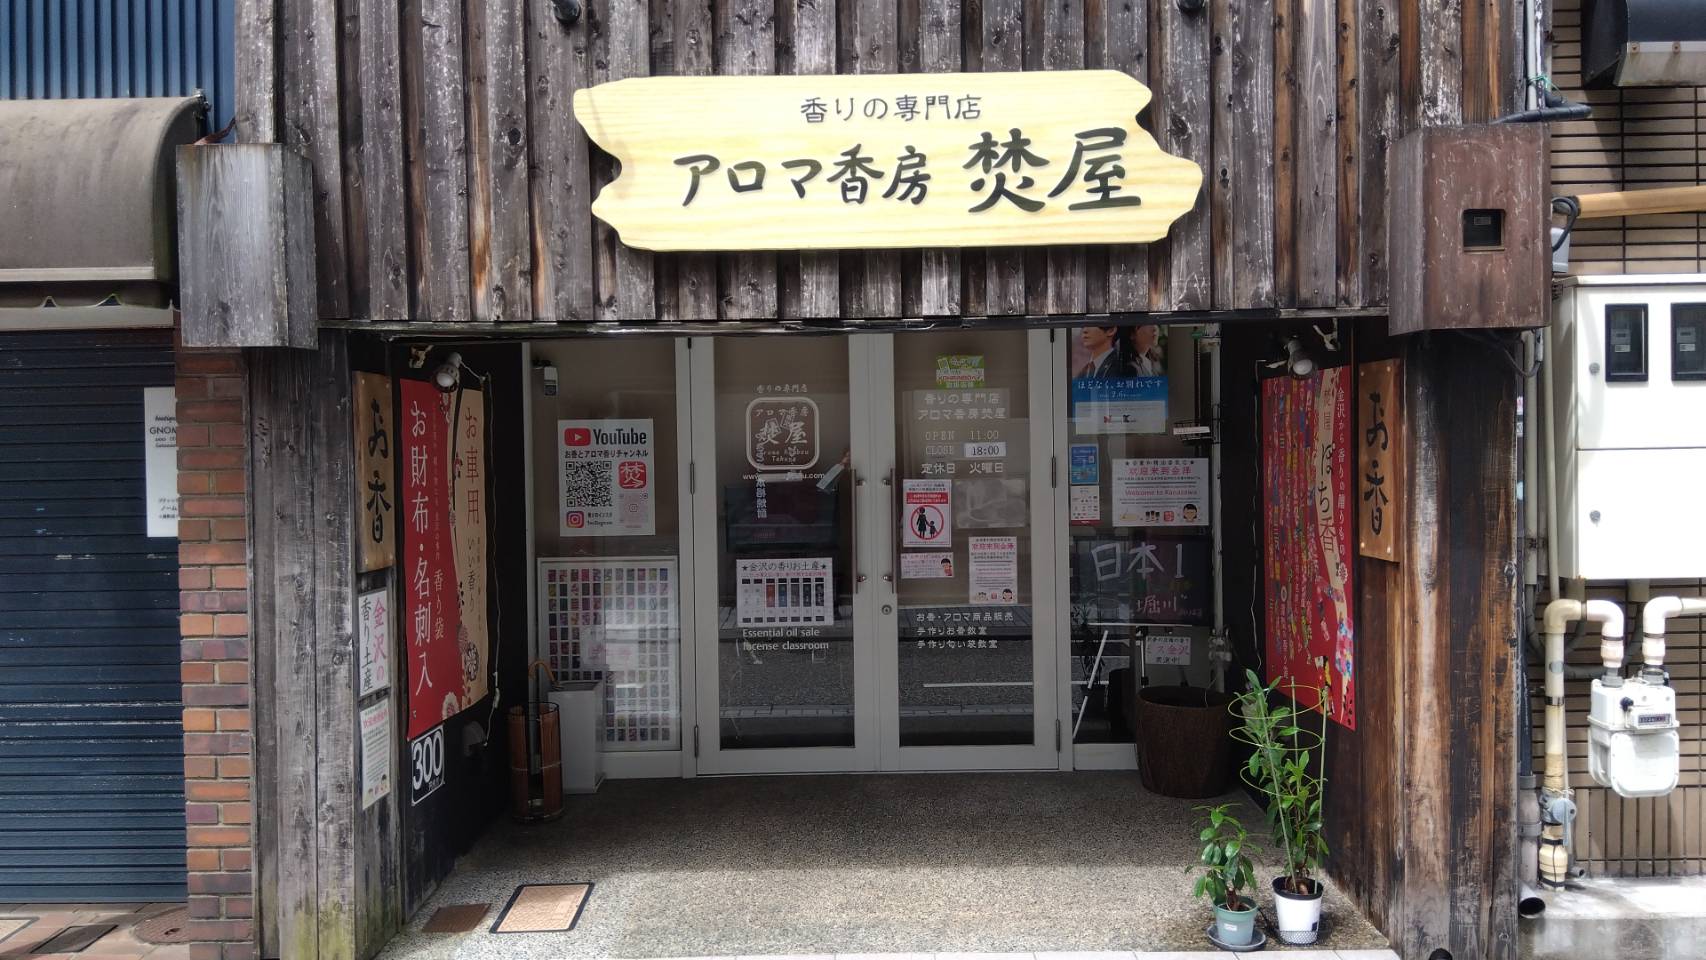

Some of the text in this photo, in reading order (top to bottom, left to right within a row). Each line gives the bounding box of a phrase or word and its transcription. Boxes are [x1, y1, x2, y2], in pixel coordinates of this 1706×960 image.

[800, 94, 983, 124] 香りの専門店
[673, 126, 1143, 215] アロマ香房 焚屋
[924, 392, 1001, 404] 香りの専門店
[1077, 379, 1164, 390] ほどなく、お別れです
[593, 427, 647, 446] YouTube
[925, 430, 999, 441] OPEN 11:00
[925, 445, 1000, 456] CLOSE 18:00
[366, 398, 392, 543] お香
[465, 407, 480, 526] お車用
[920, 462, 1004, 474] 定休日 火曜日
[1362, 391, 1390, 536] お香
[411, 400, 433, 696] お財布・名刺入
[433, 569, 446, 640] 香り袋
[360, 597, 374, 692] 香り土産
[371, 596, 388, 683] 金沢の
[742, 627, 821, 638] Essential oil sale
[783, 641, 829, 651] classroom
[916, 626, 988, 636] 手作りお香教室
[412, 729, 444, 791] 300
